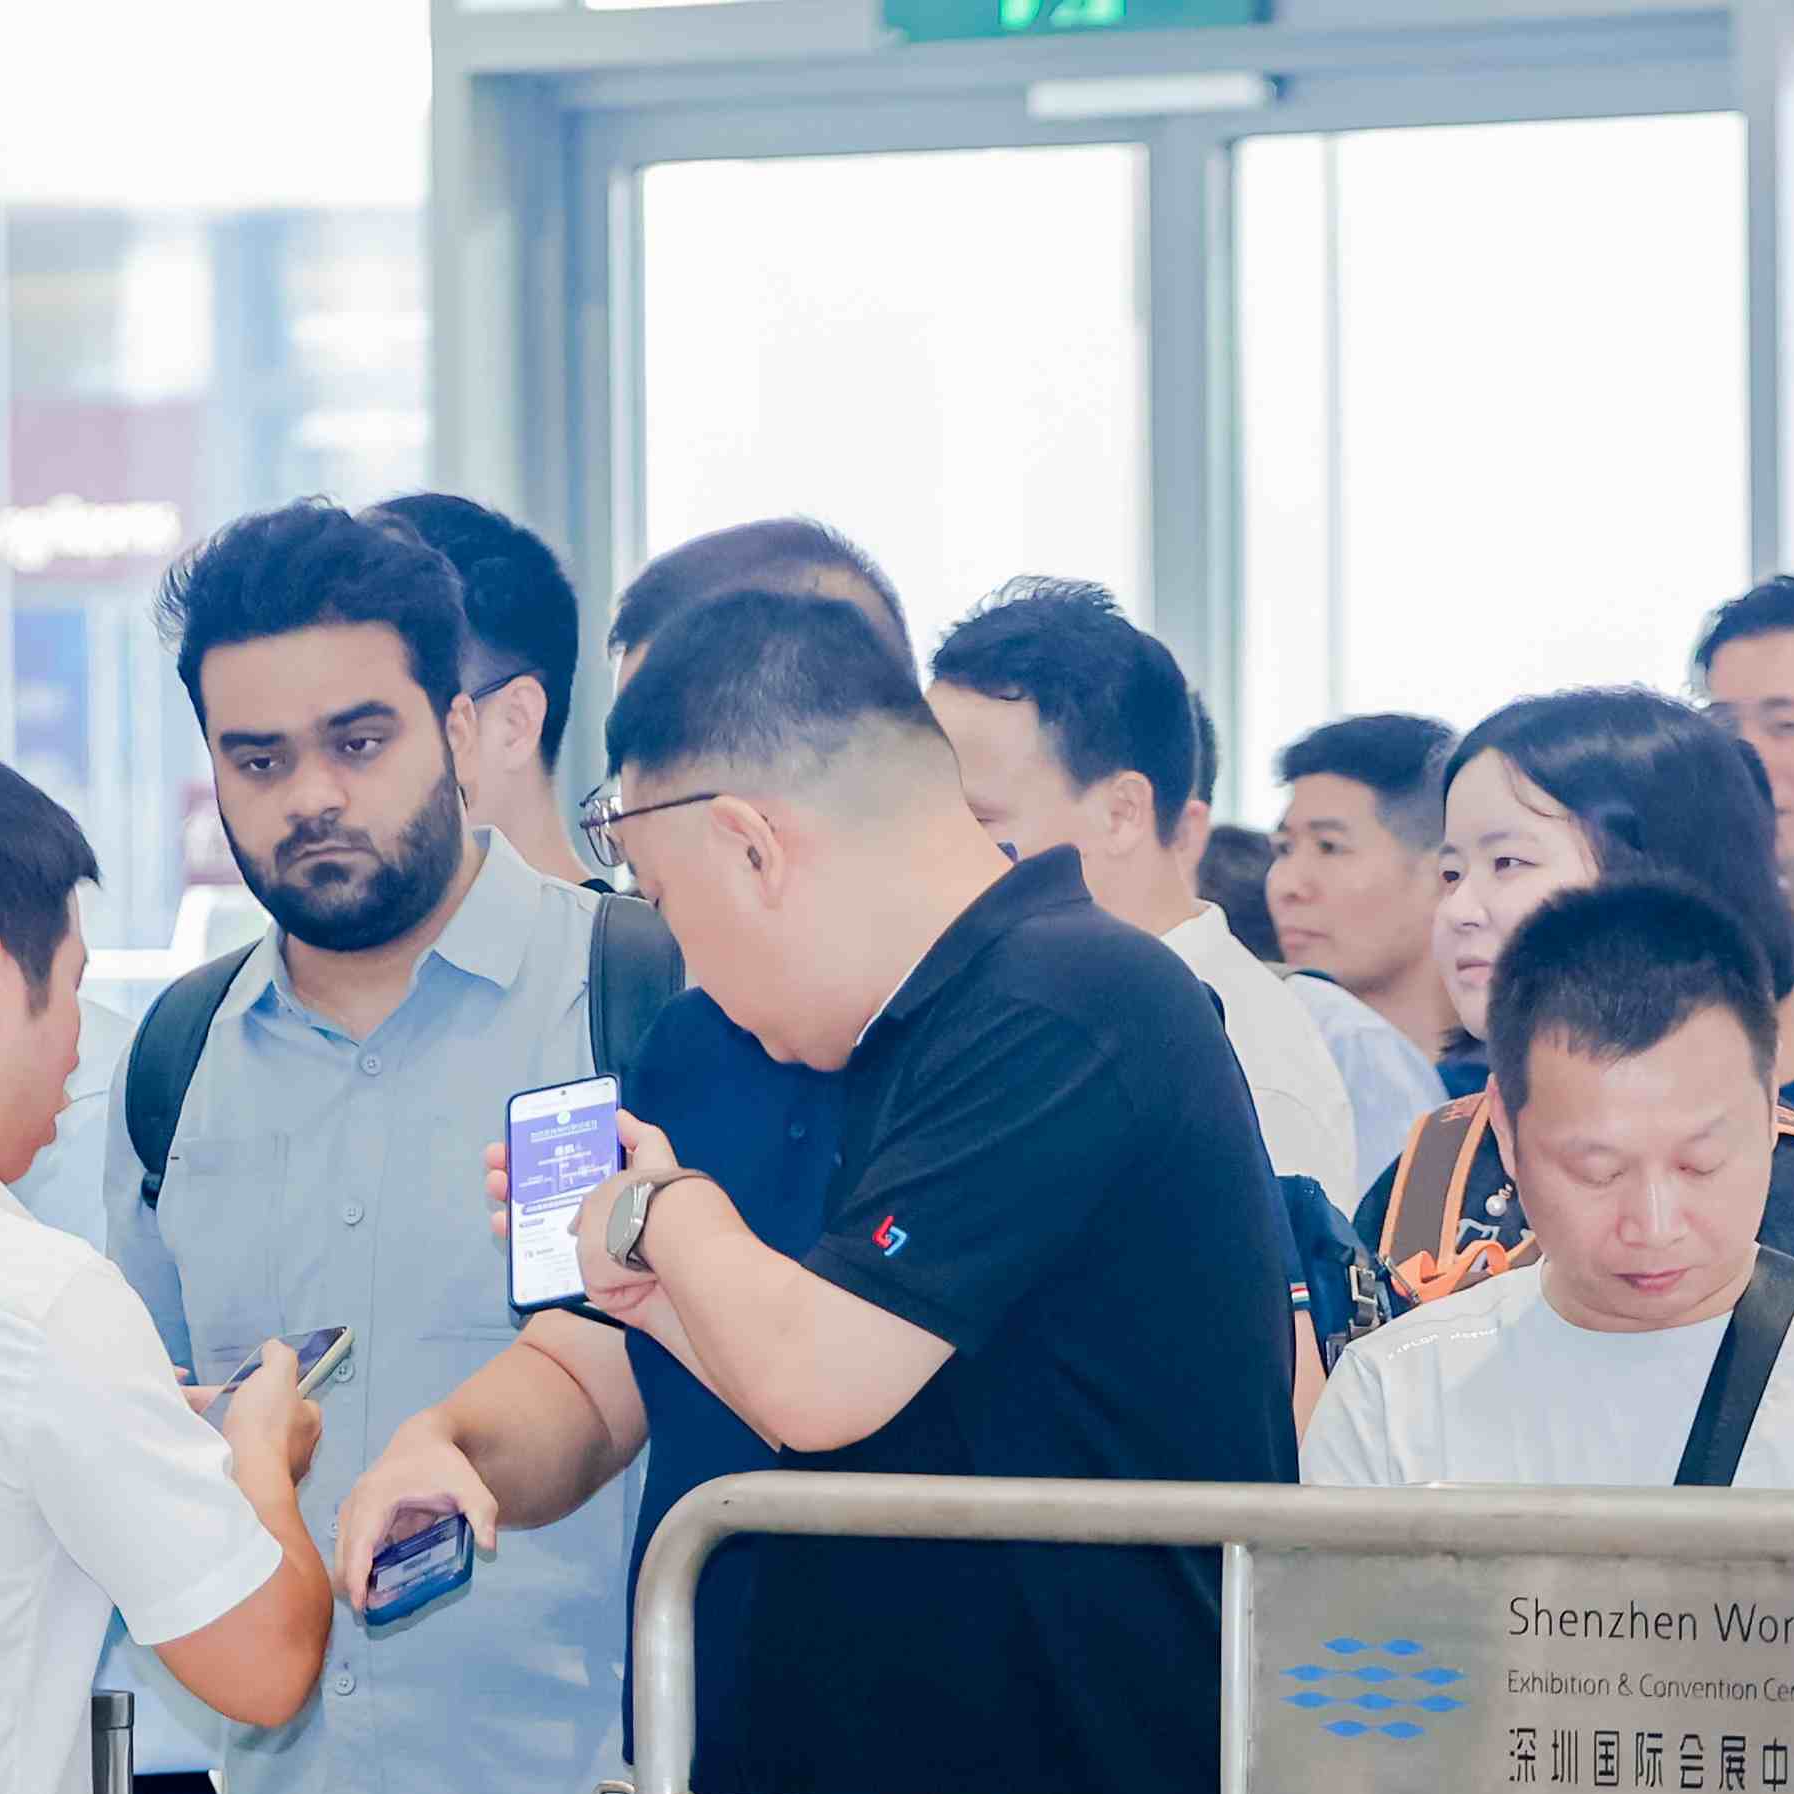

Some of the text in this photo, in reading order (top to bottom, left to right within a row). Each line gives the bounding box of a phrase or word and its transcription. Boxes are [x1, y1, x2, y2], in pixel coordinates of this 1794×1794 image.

[1509, 1597, 1698, 1641] Shenzhen
[1507, 1669, 1610, 1697] Exhibition
[1617, 1672, 1634, 1697] &
[1639, 1672, 1758, 1702] Convention
